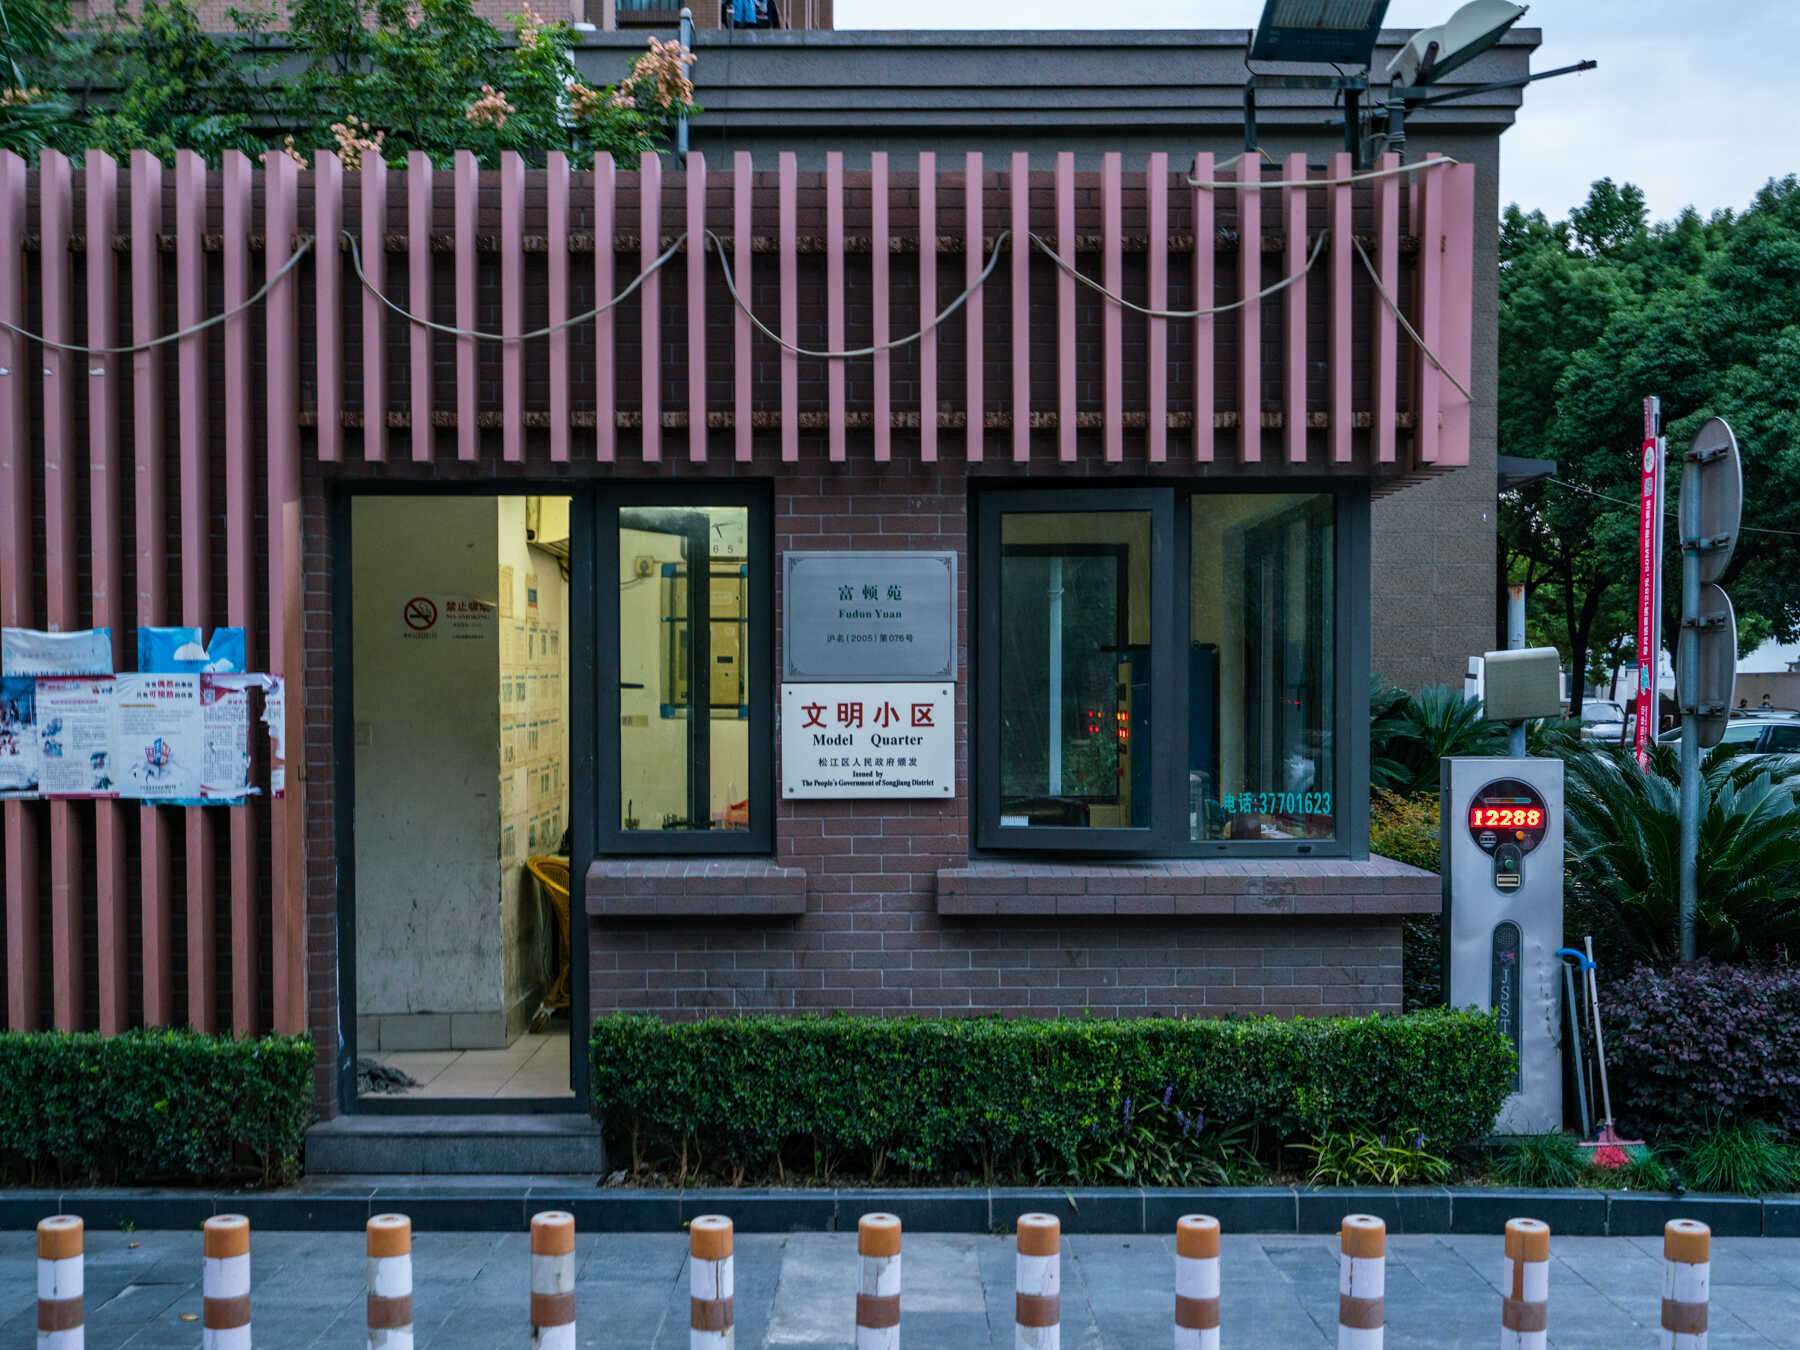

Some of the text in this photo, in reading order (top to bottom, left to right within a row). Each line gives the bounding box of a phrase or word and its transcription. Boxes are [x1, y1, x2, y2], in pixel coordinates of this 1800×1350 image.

[727, 544, 734, 553] 5
[838, 584, 903, 601] 富顿苑
[875, 609, 902, 619] Yuan
[801, 702, 935, 728] 文明小区
[812, 734, 924, 748] Model Quarter
[818, 757, 918, 767] 松江区人民政府颁发
[853, 770, 883, 779] Issued by
[814, 779, 837, 788] People's
[875, 779, 881, 787] of
[882, 780, 911, 788] Songjiang
[912, 779, 934, 787] District
[1223, 791, 1331, 815] 电话:37701623
